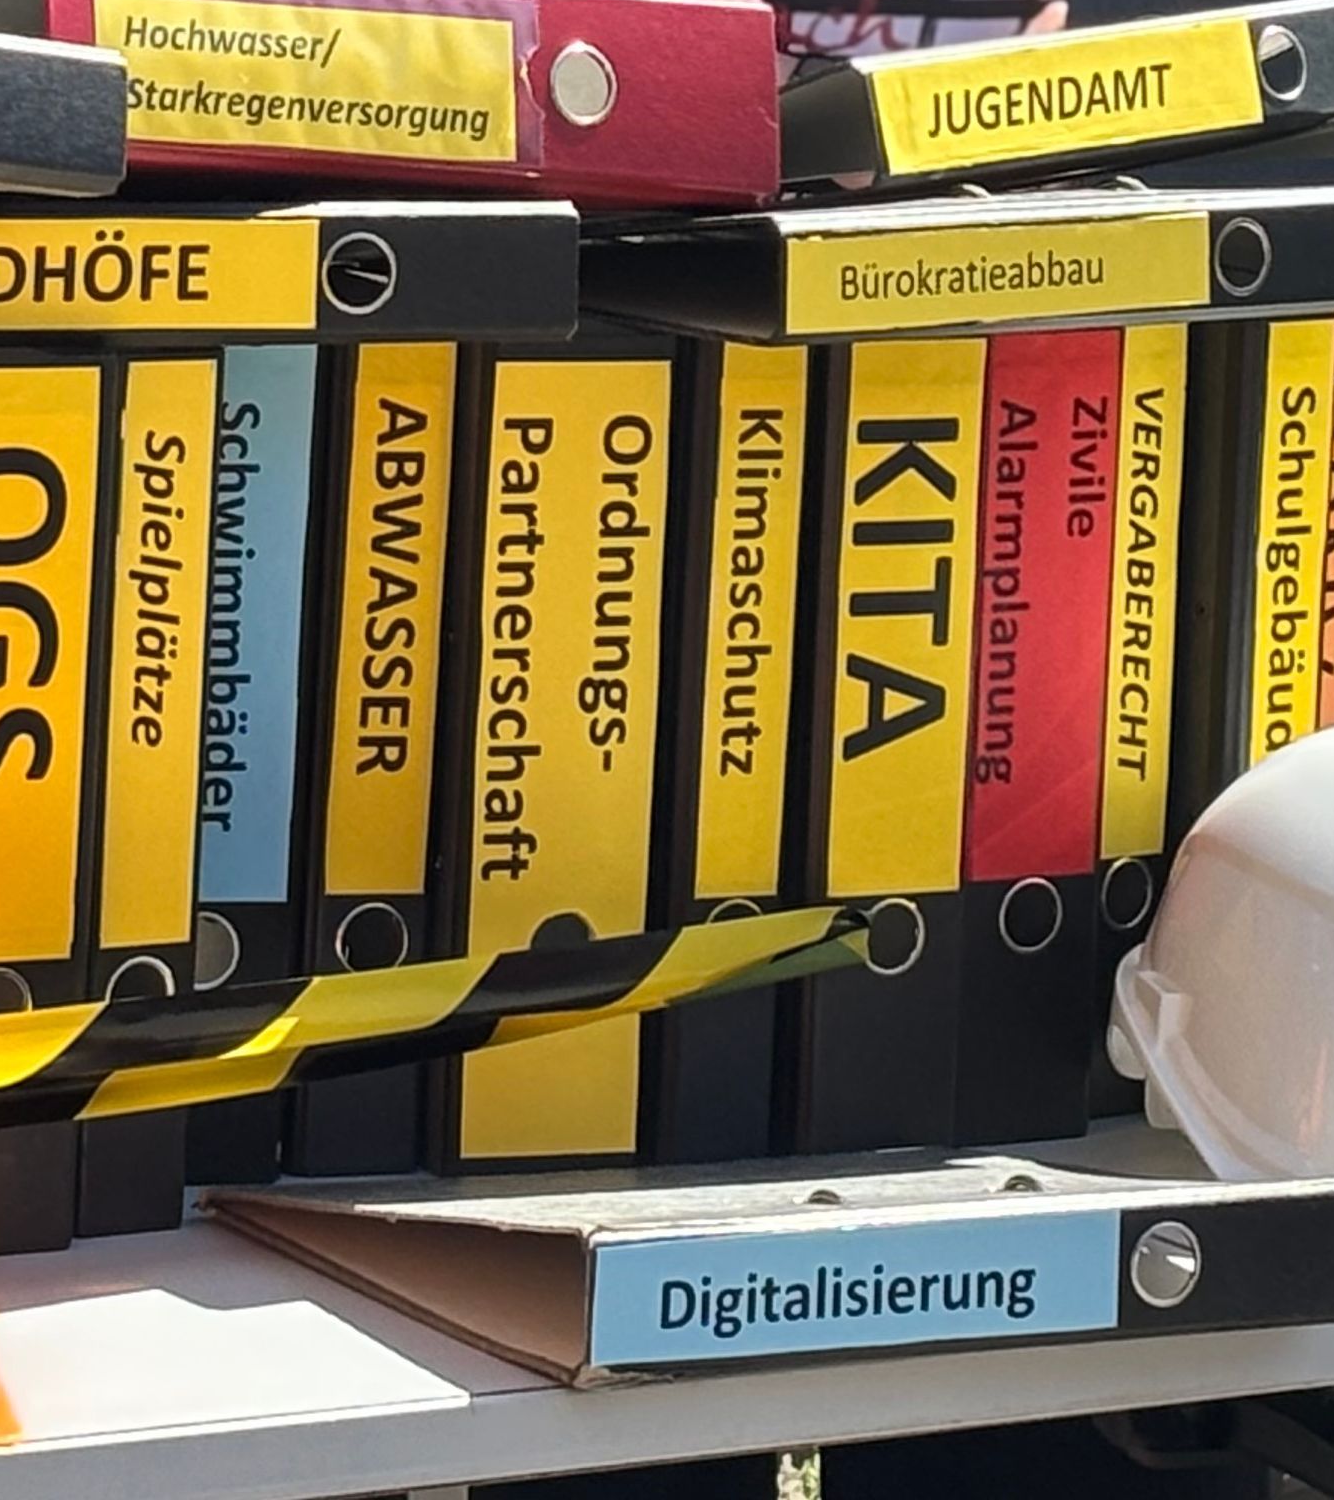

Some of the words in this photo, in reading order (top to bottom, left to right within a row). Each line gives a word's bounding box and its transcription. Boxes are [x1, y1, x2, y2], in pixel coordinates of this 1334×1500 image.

[124, 15, 342, 67] Hochwasser/
[127, 77, 489, 141] Starkregenversorgung
[927, 63, 1172, 139] JUGENDAMT
[839, 251, 1105, 301] Bürokratieabbau
[128, 430, 186, 750] Spielplätze
[202, 400, 262, 833] Schwimmbäder
[354, 397, 428, 777] ABWASSER
[578, 414, 652, 773] Ordnungs-
[719, 408, 785, 777] Klimaschutz
[842, 417, 960, 763] KITA
[975, 399, 1040, 785] Alarmplanung
[1066, 396, 1108, 538] Zivile
[1116, 386, 1166, 781] VERGABERECHT
[1264, 386, 1317, 751] Schulgebäud
[481, 416, 555, 882] Partnerschaft
[660, 1261, 1037, 1340] Digitalisierung
